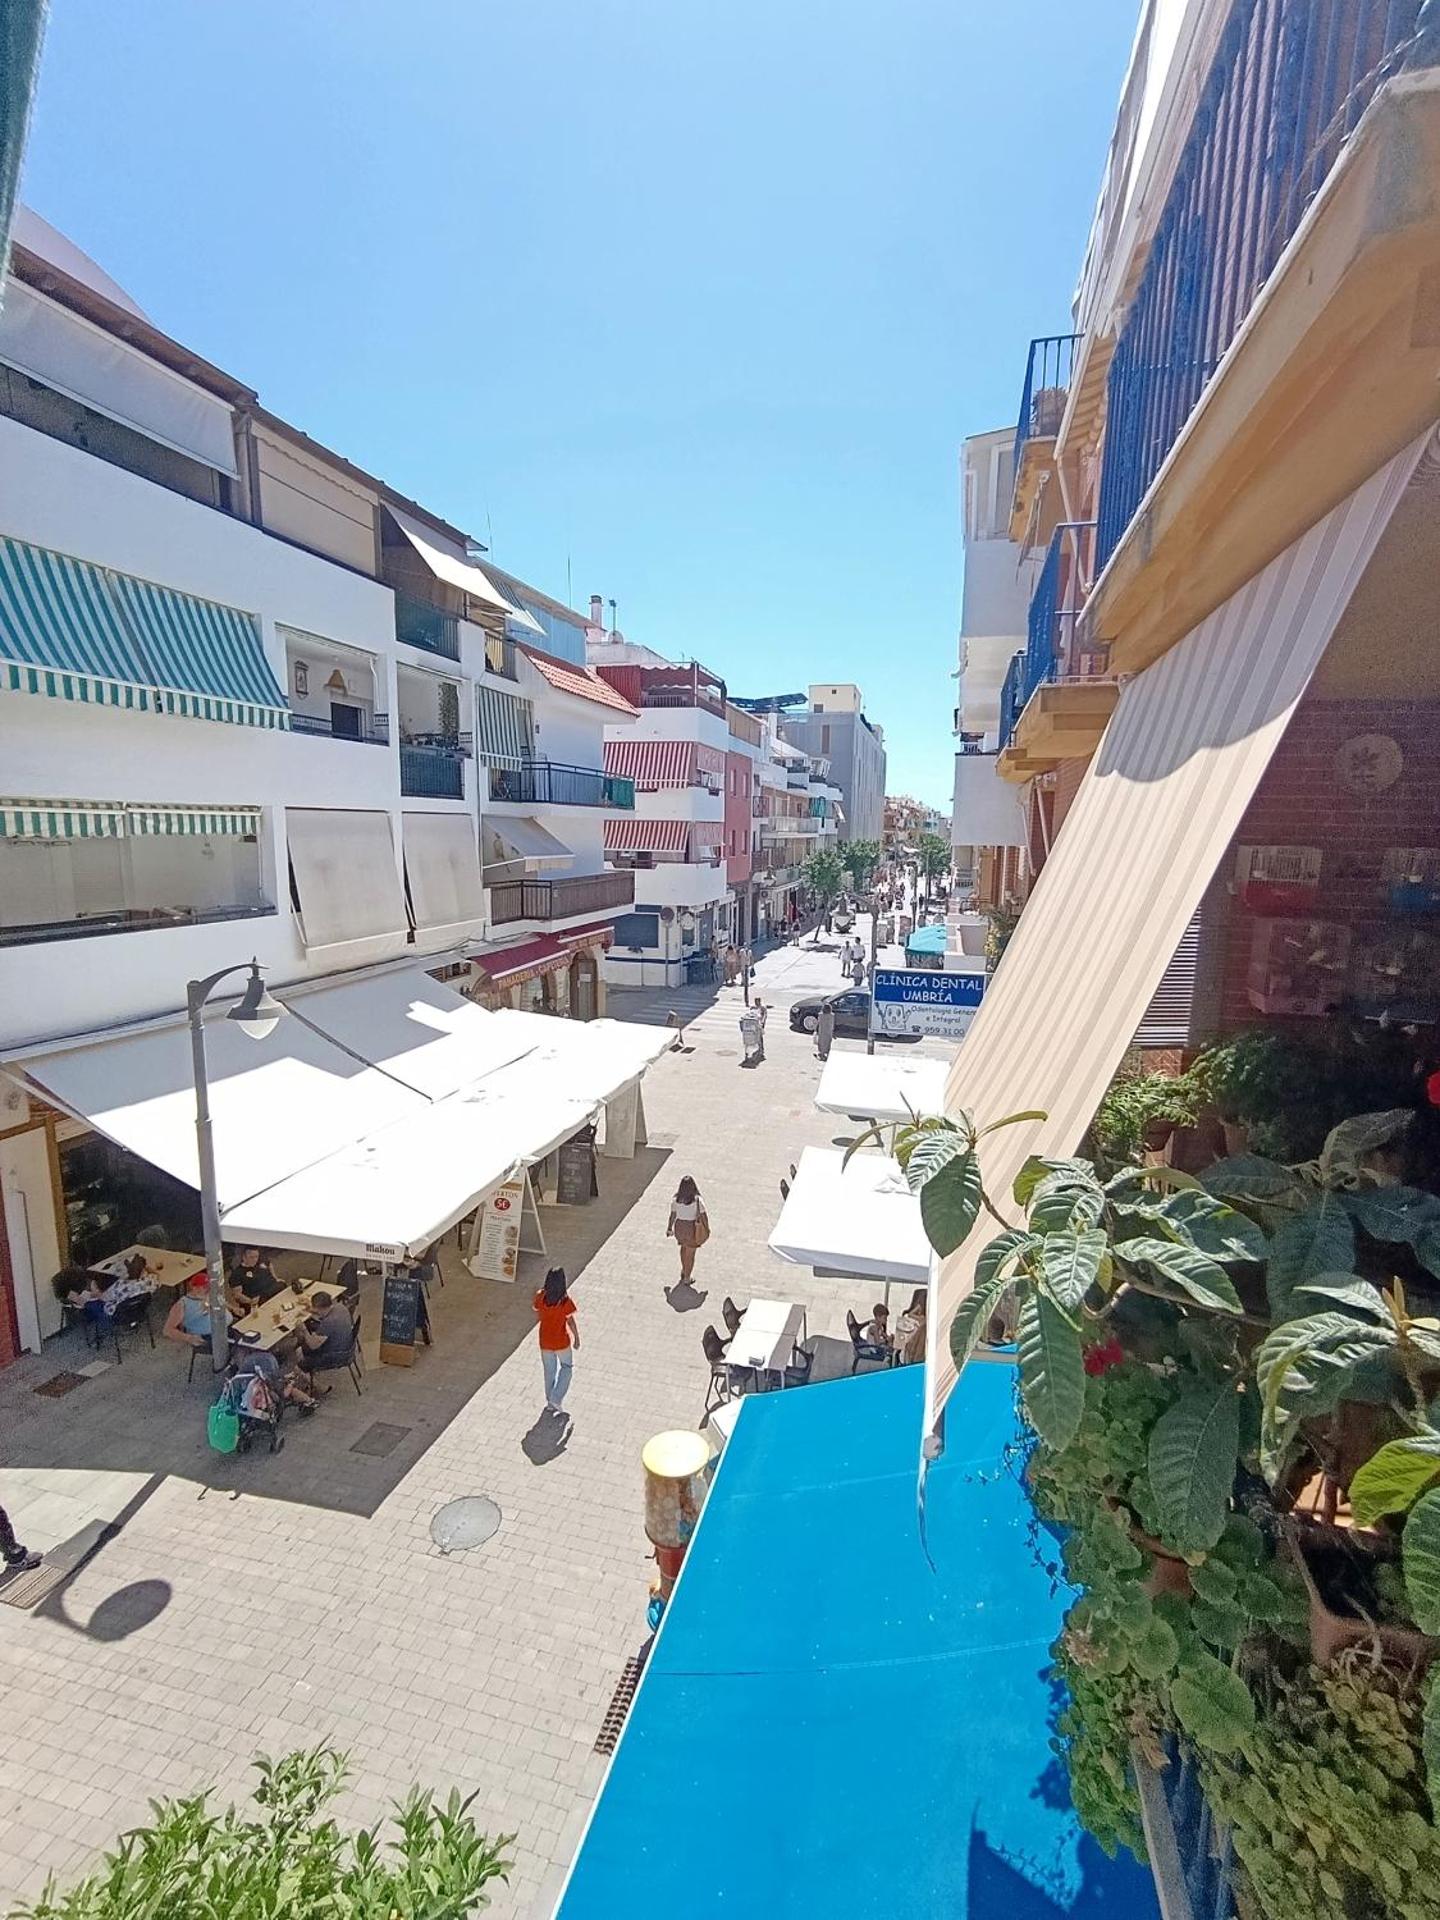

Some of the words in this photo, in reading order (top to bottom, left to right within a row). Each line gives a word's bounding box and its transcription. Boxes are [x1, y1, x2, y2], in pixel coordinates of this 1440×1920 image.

[876, 973, 928, 987] CLÍNICA
[932, 977, 983, 991] DENTAL
[903, 989, 953, 1003] UMBRÍA
[953, 1006, 977, 1016] Gener
[924, 1026, 940, 1034] 959
[366, 1243, 395, 1255] Mahou
